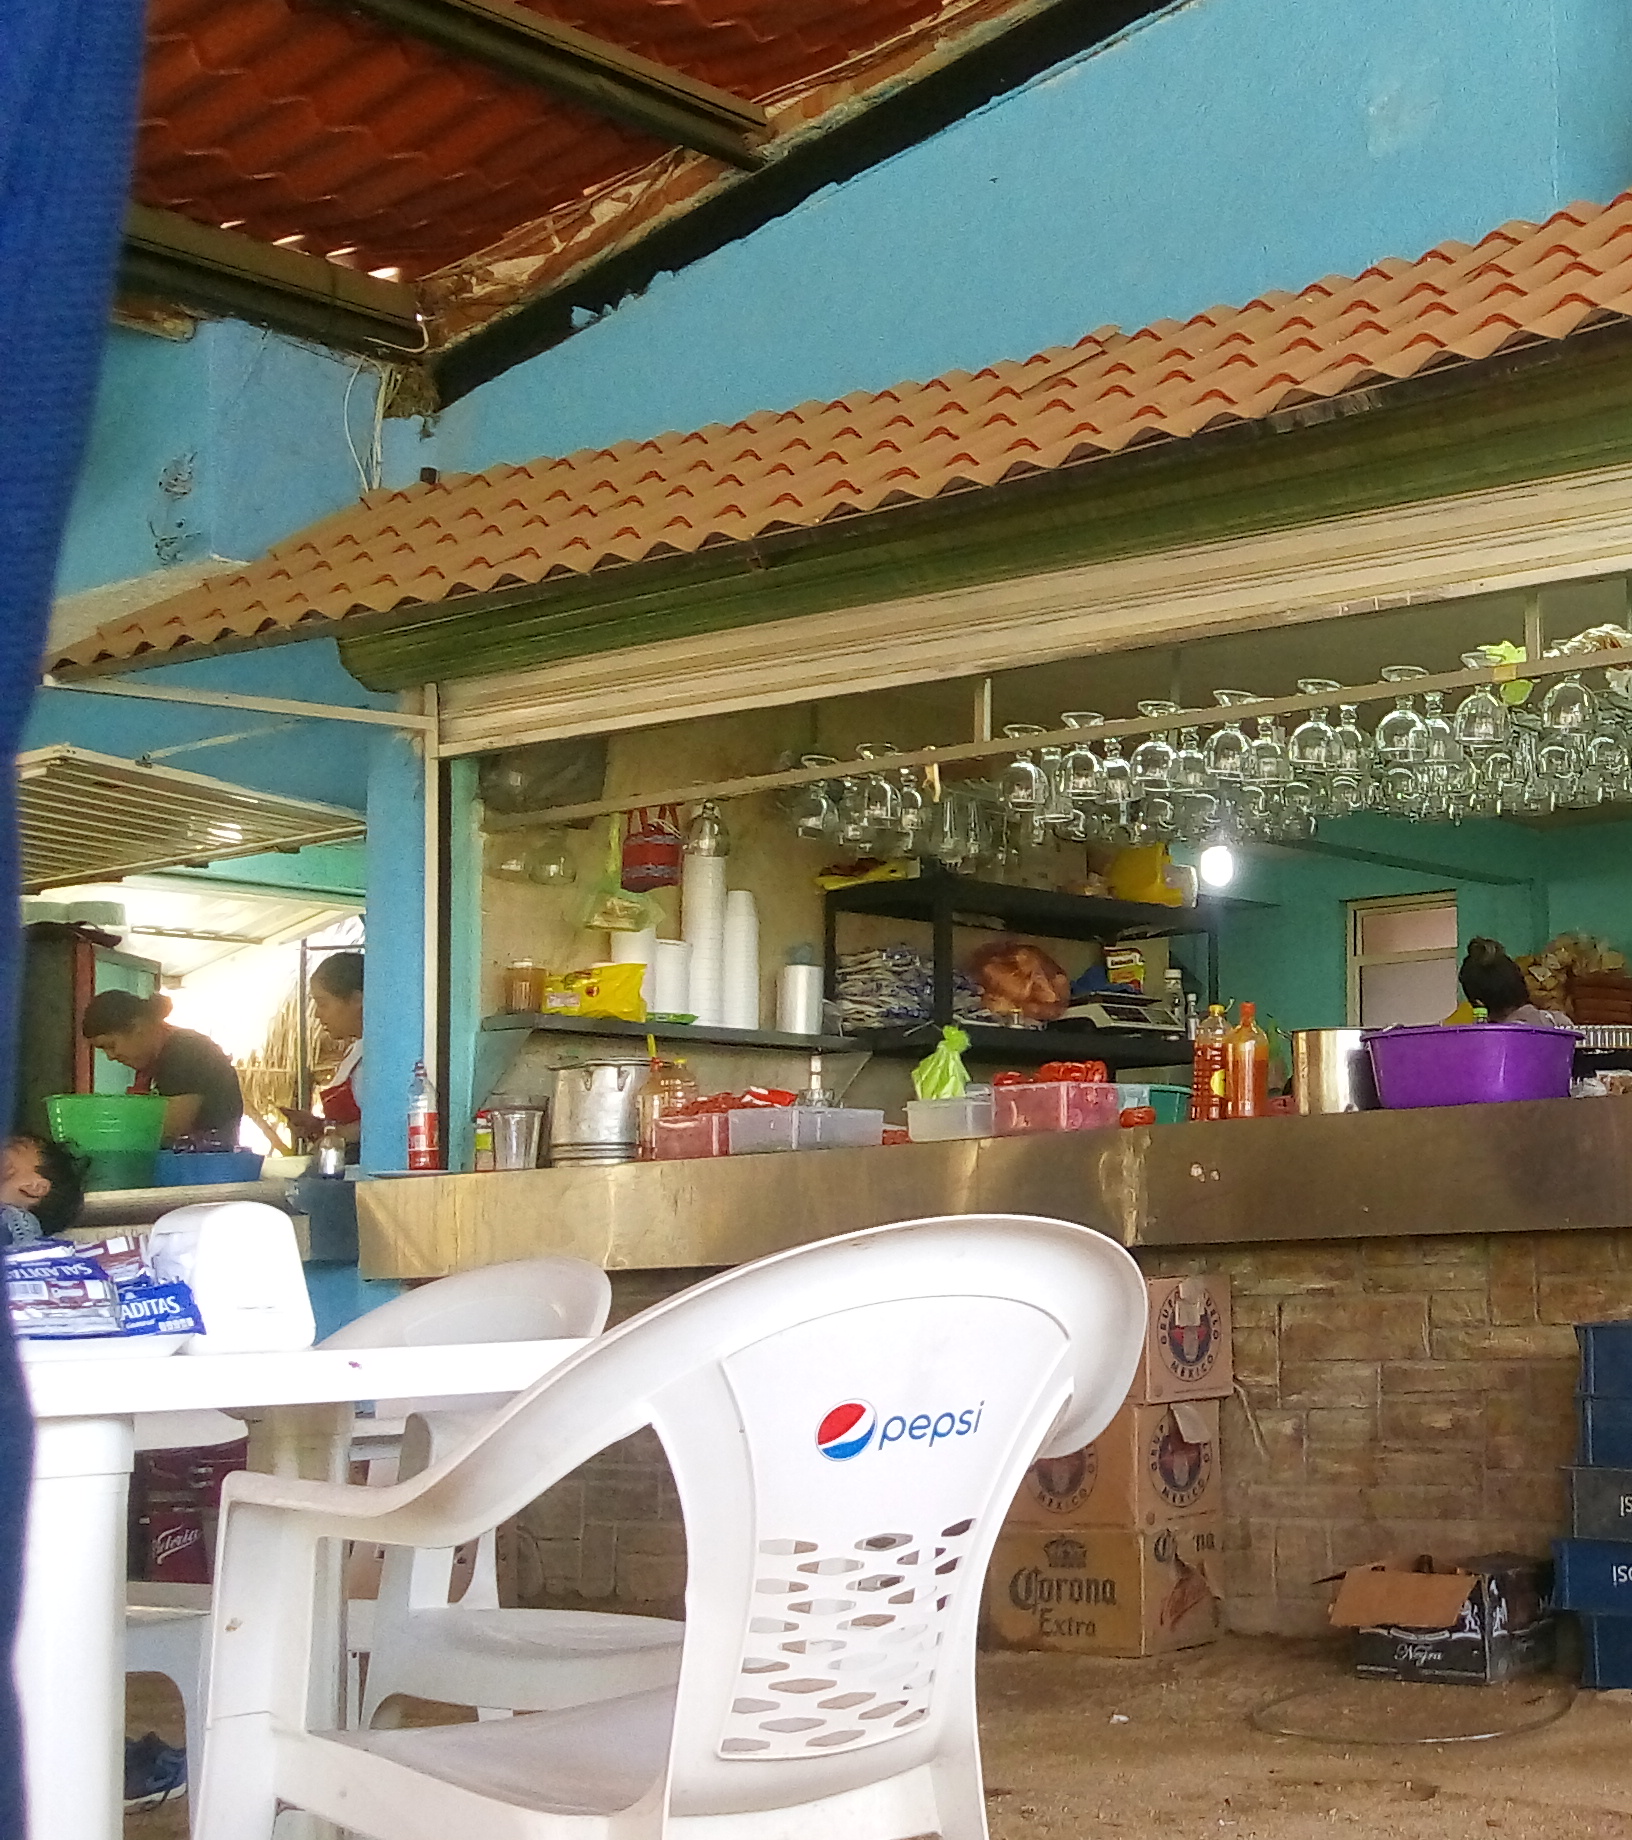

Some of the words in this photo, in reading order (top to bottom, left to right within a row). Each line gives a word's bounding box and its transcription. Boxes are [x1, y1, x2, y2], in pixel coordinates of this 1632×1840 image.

[119, 1296, 182, 1321] ADITAS
[878, 1400, 985, 1451] pepsi
[1009, 1566, 1117, 1615] Corona
[1039, 1608, 1096, 1637] Extra
